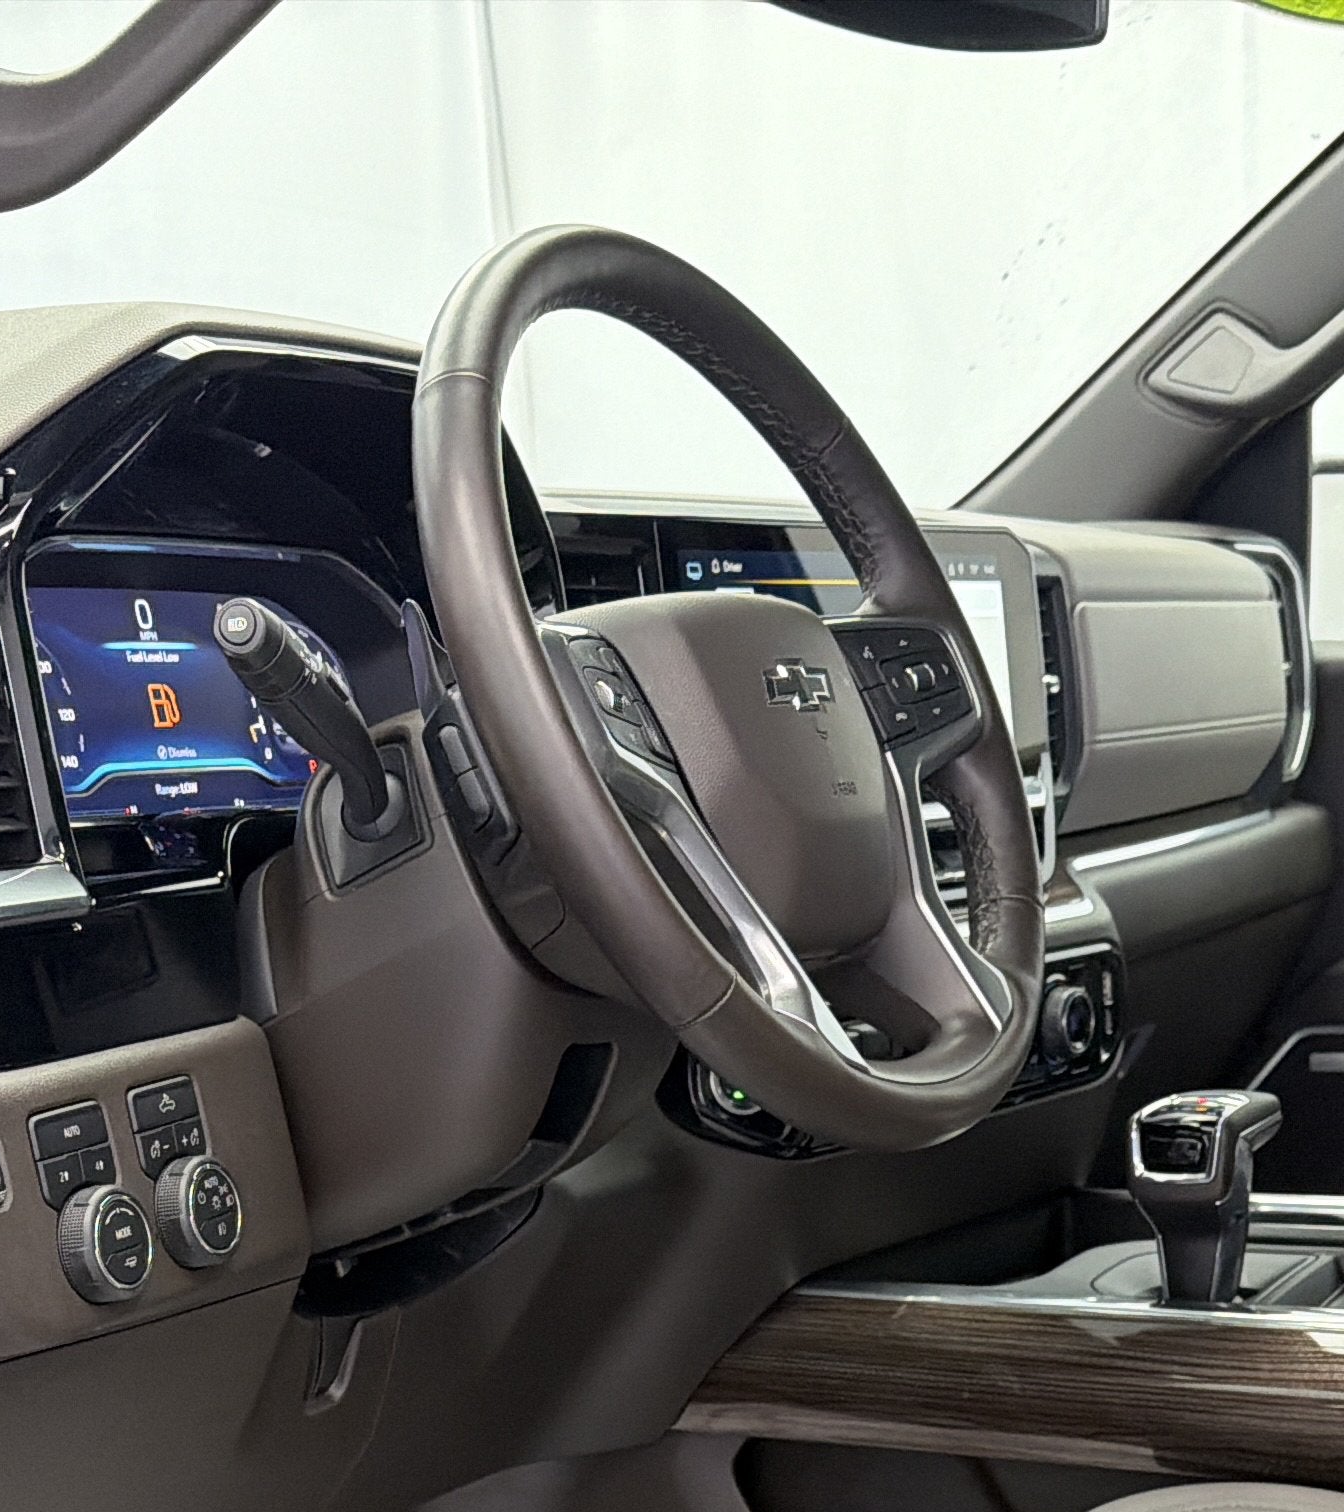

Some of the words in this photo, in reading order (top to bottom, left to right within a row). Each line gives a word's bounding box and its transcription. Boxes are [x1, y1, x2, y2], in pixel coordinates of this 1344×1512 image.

[135, 599, 153, 630] 0
[35, 661, 53, 674] 00
[58, 708, 76, 722] 120
[60, 754, 79, 768] 140
[63, 1124, 81, 1139] AUTO
[114, 1225, 133, 1241] MODE
